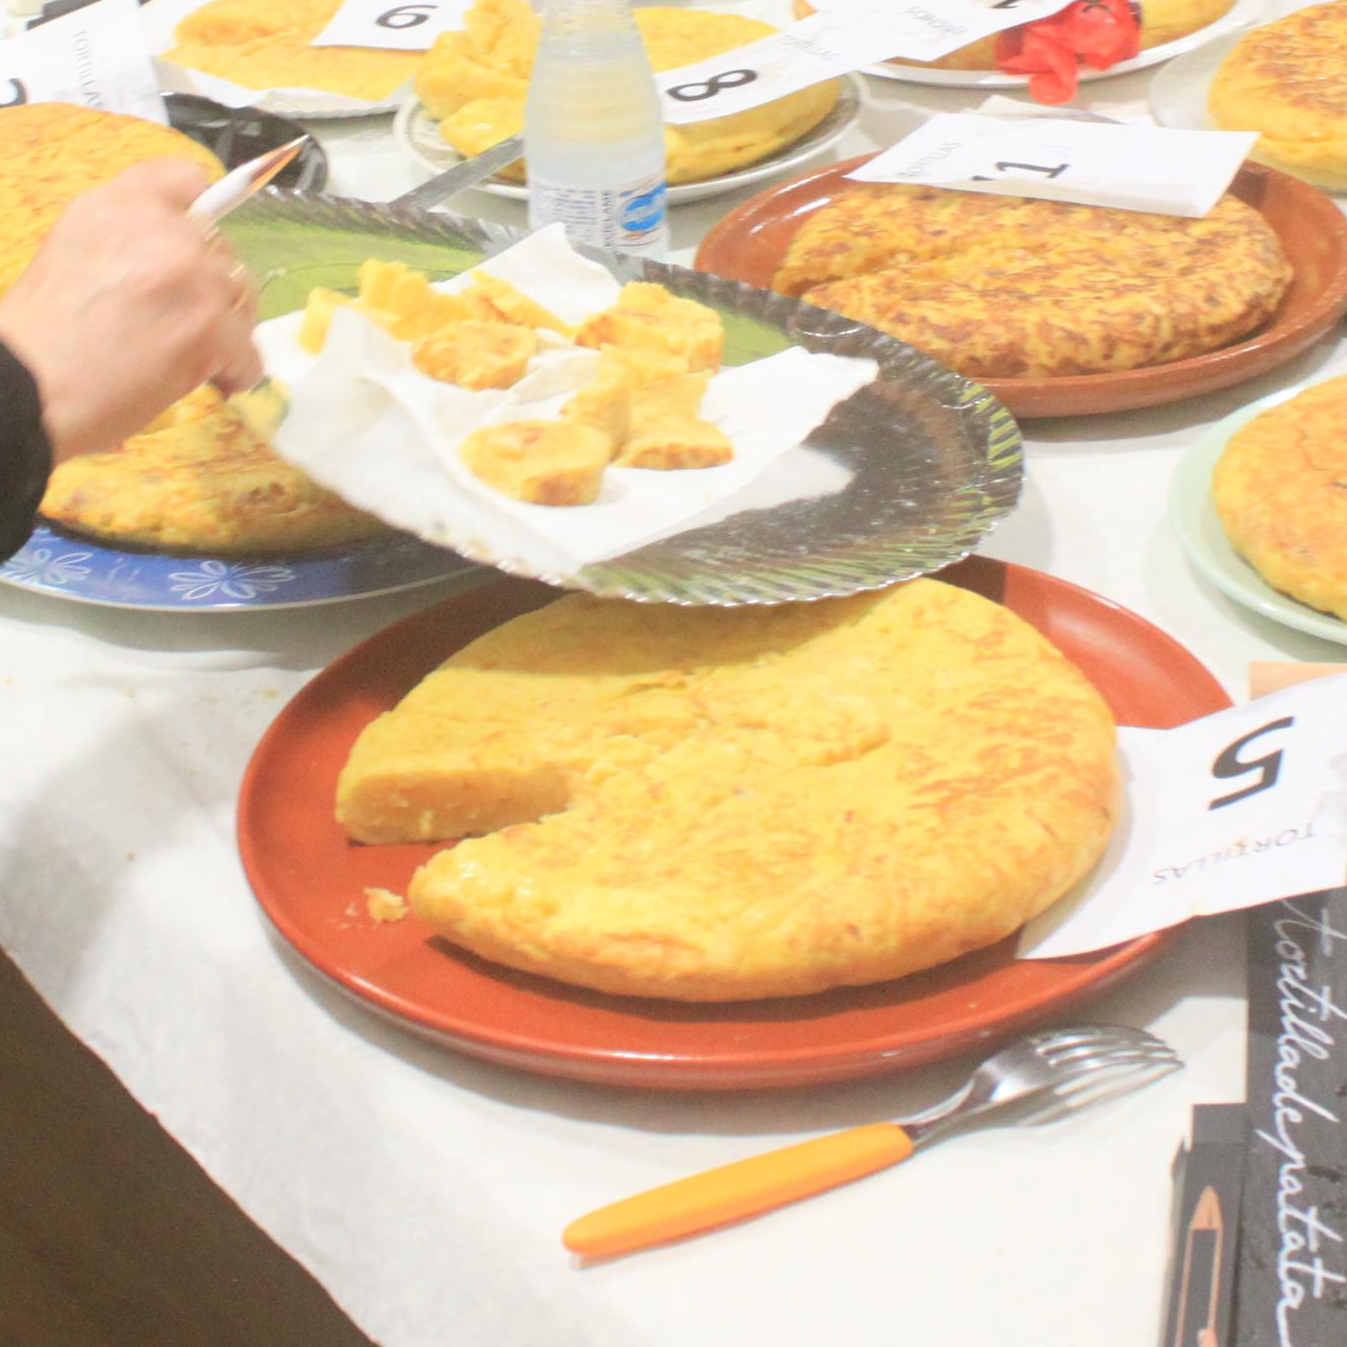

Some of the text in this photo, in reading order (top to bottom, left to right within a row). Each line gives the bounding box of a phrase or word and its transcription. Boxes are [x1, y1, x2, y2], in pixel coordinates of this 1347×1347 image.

[666, 68, 760, 103] 8
[1207, 715, 1296, 812] 5
[1151, 821, 1317, 886] TORTILLAS
